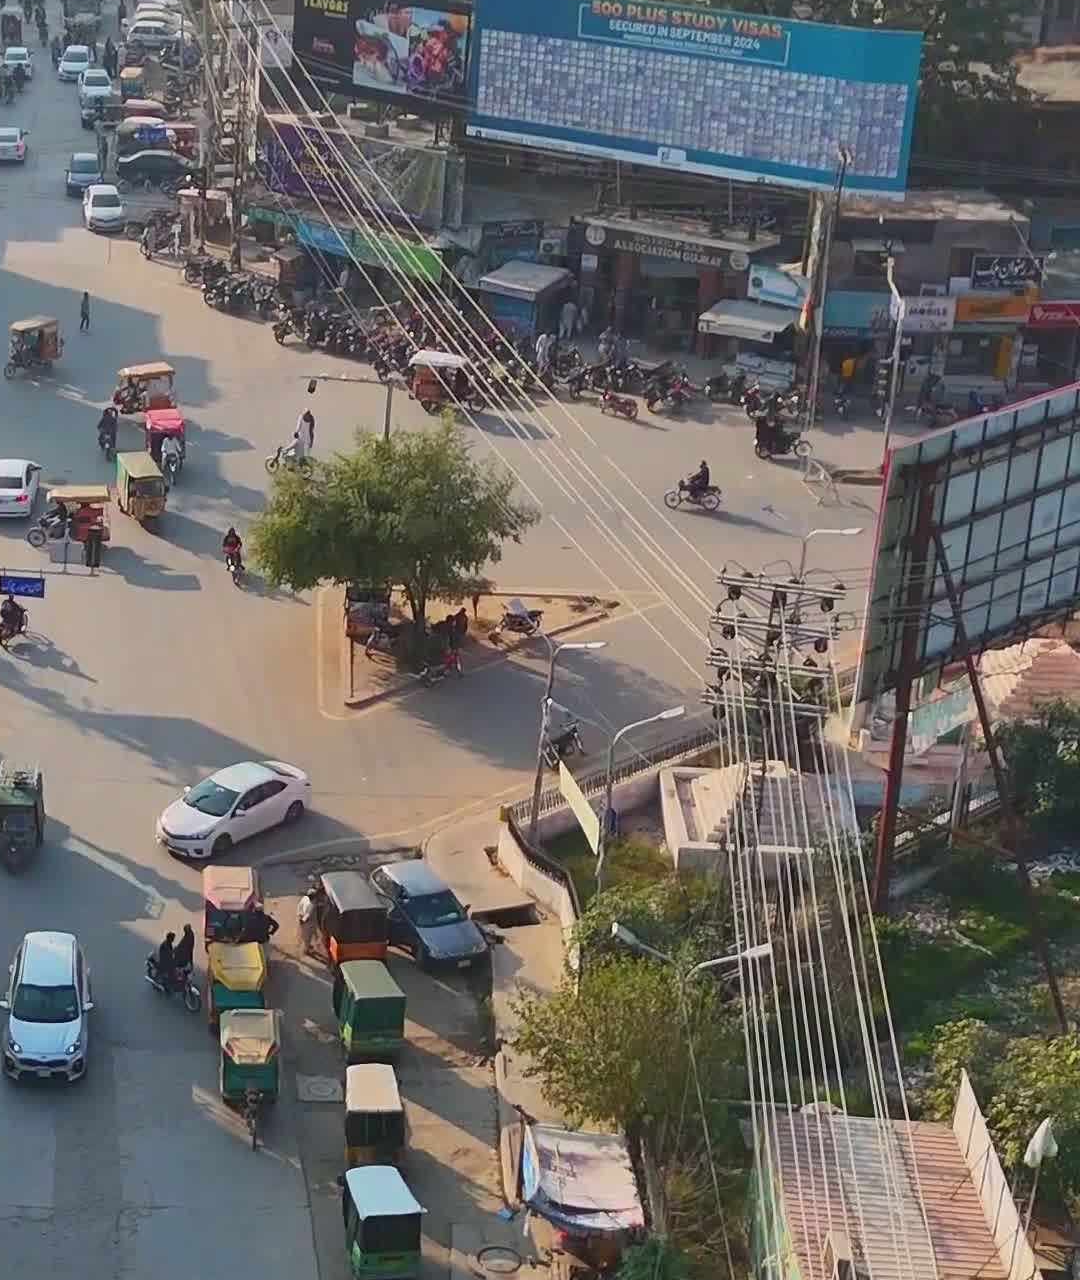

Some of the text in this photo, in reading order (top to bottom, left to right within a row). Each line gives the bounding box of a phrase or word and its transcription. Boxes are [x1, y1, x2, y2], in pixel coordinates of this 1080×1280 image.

[591, 0, 783, 38] 500 PLUS STUDY VISAS
[609, 19, 656, 36] SECURED
[656, 25, 669, 36] IN
[669, 27, 732, 46] SEPTEMBER
[733, 36, 761, 51] 2024
[614, 241, 723, 268] ASSOCIATION GUJRAT
